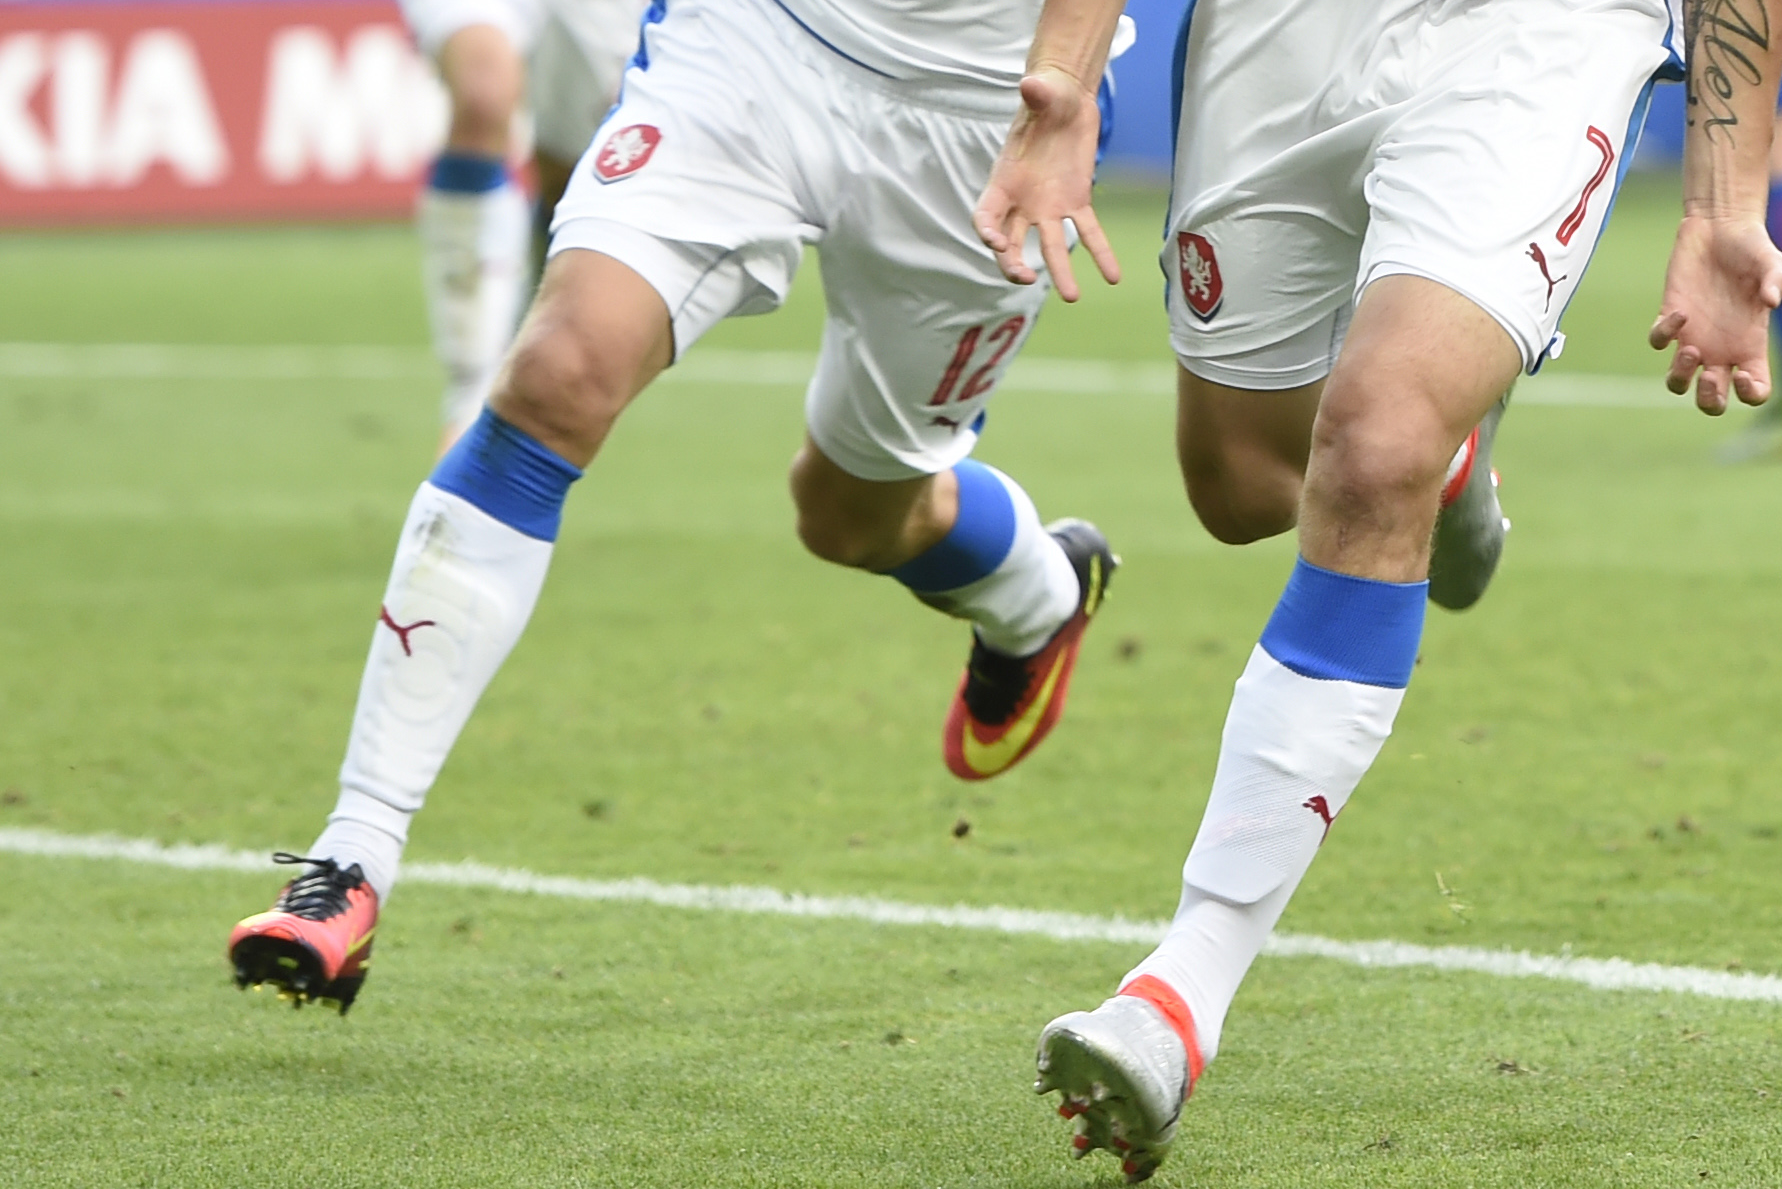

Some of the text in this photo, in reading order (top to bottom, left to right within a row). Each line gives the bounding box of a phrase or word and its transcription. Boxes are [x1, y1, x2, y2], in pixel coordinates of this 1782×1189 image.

[0, 29, 230, 188] KIA
[1556, 125, 1615, 247] 7
[928, 314, 1025, 406] 12
